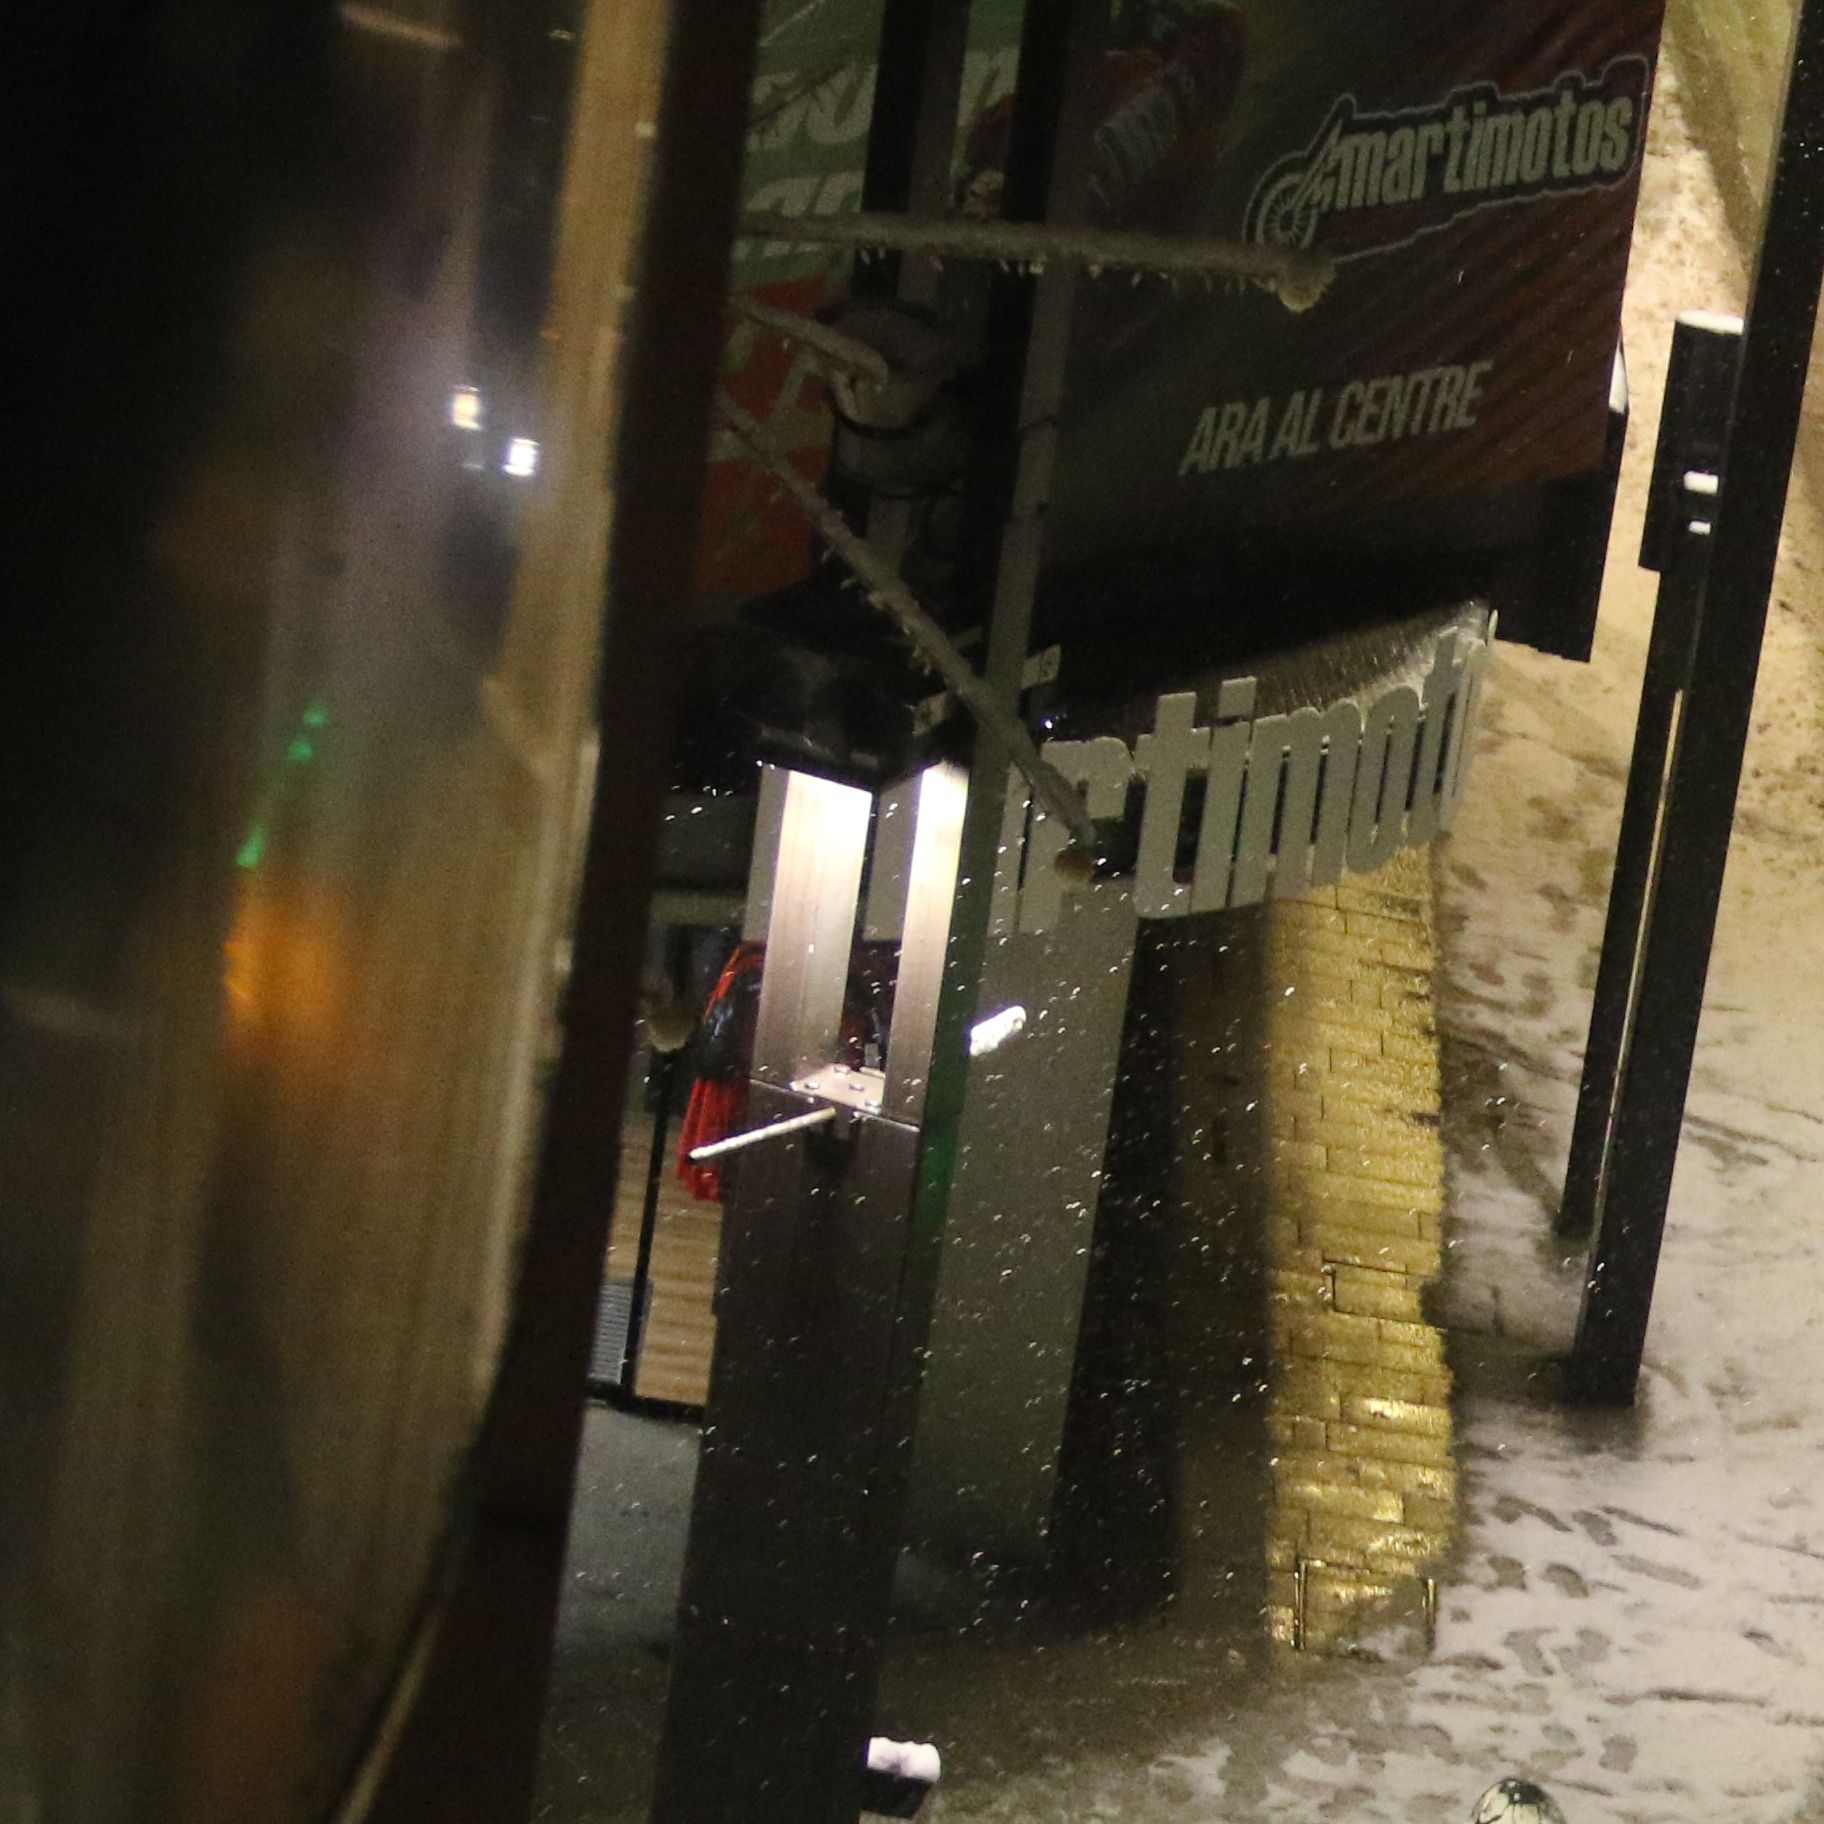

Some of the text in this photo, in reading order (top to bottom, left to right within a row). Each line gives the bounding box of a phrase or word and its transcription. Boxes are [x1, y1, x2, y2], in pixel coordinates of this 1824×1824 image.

[1326, 91, 1636, 210] martimotos
[1179, 358, 1497, 477] ARA AL CENTRE
